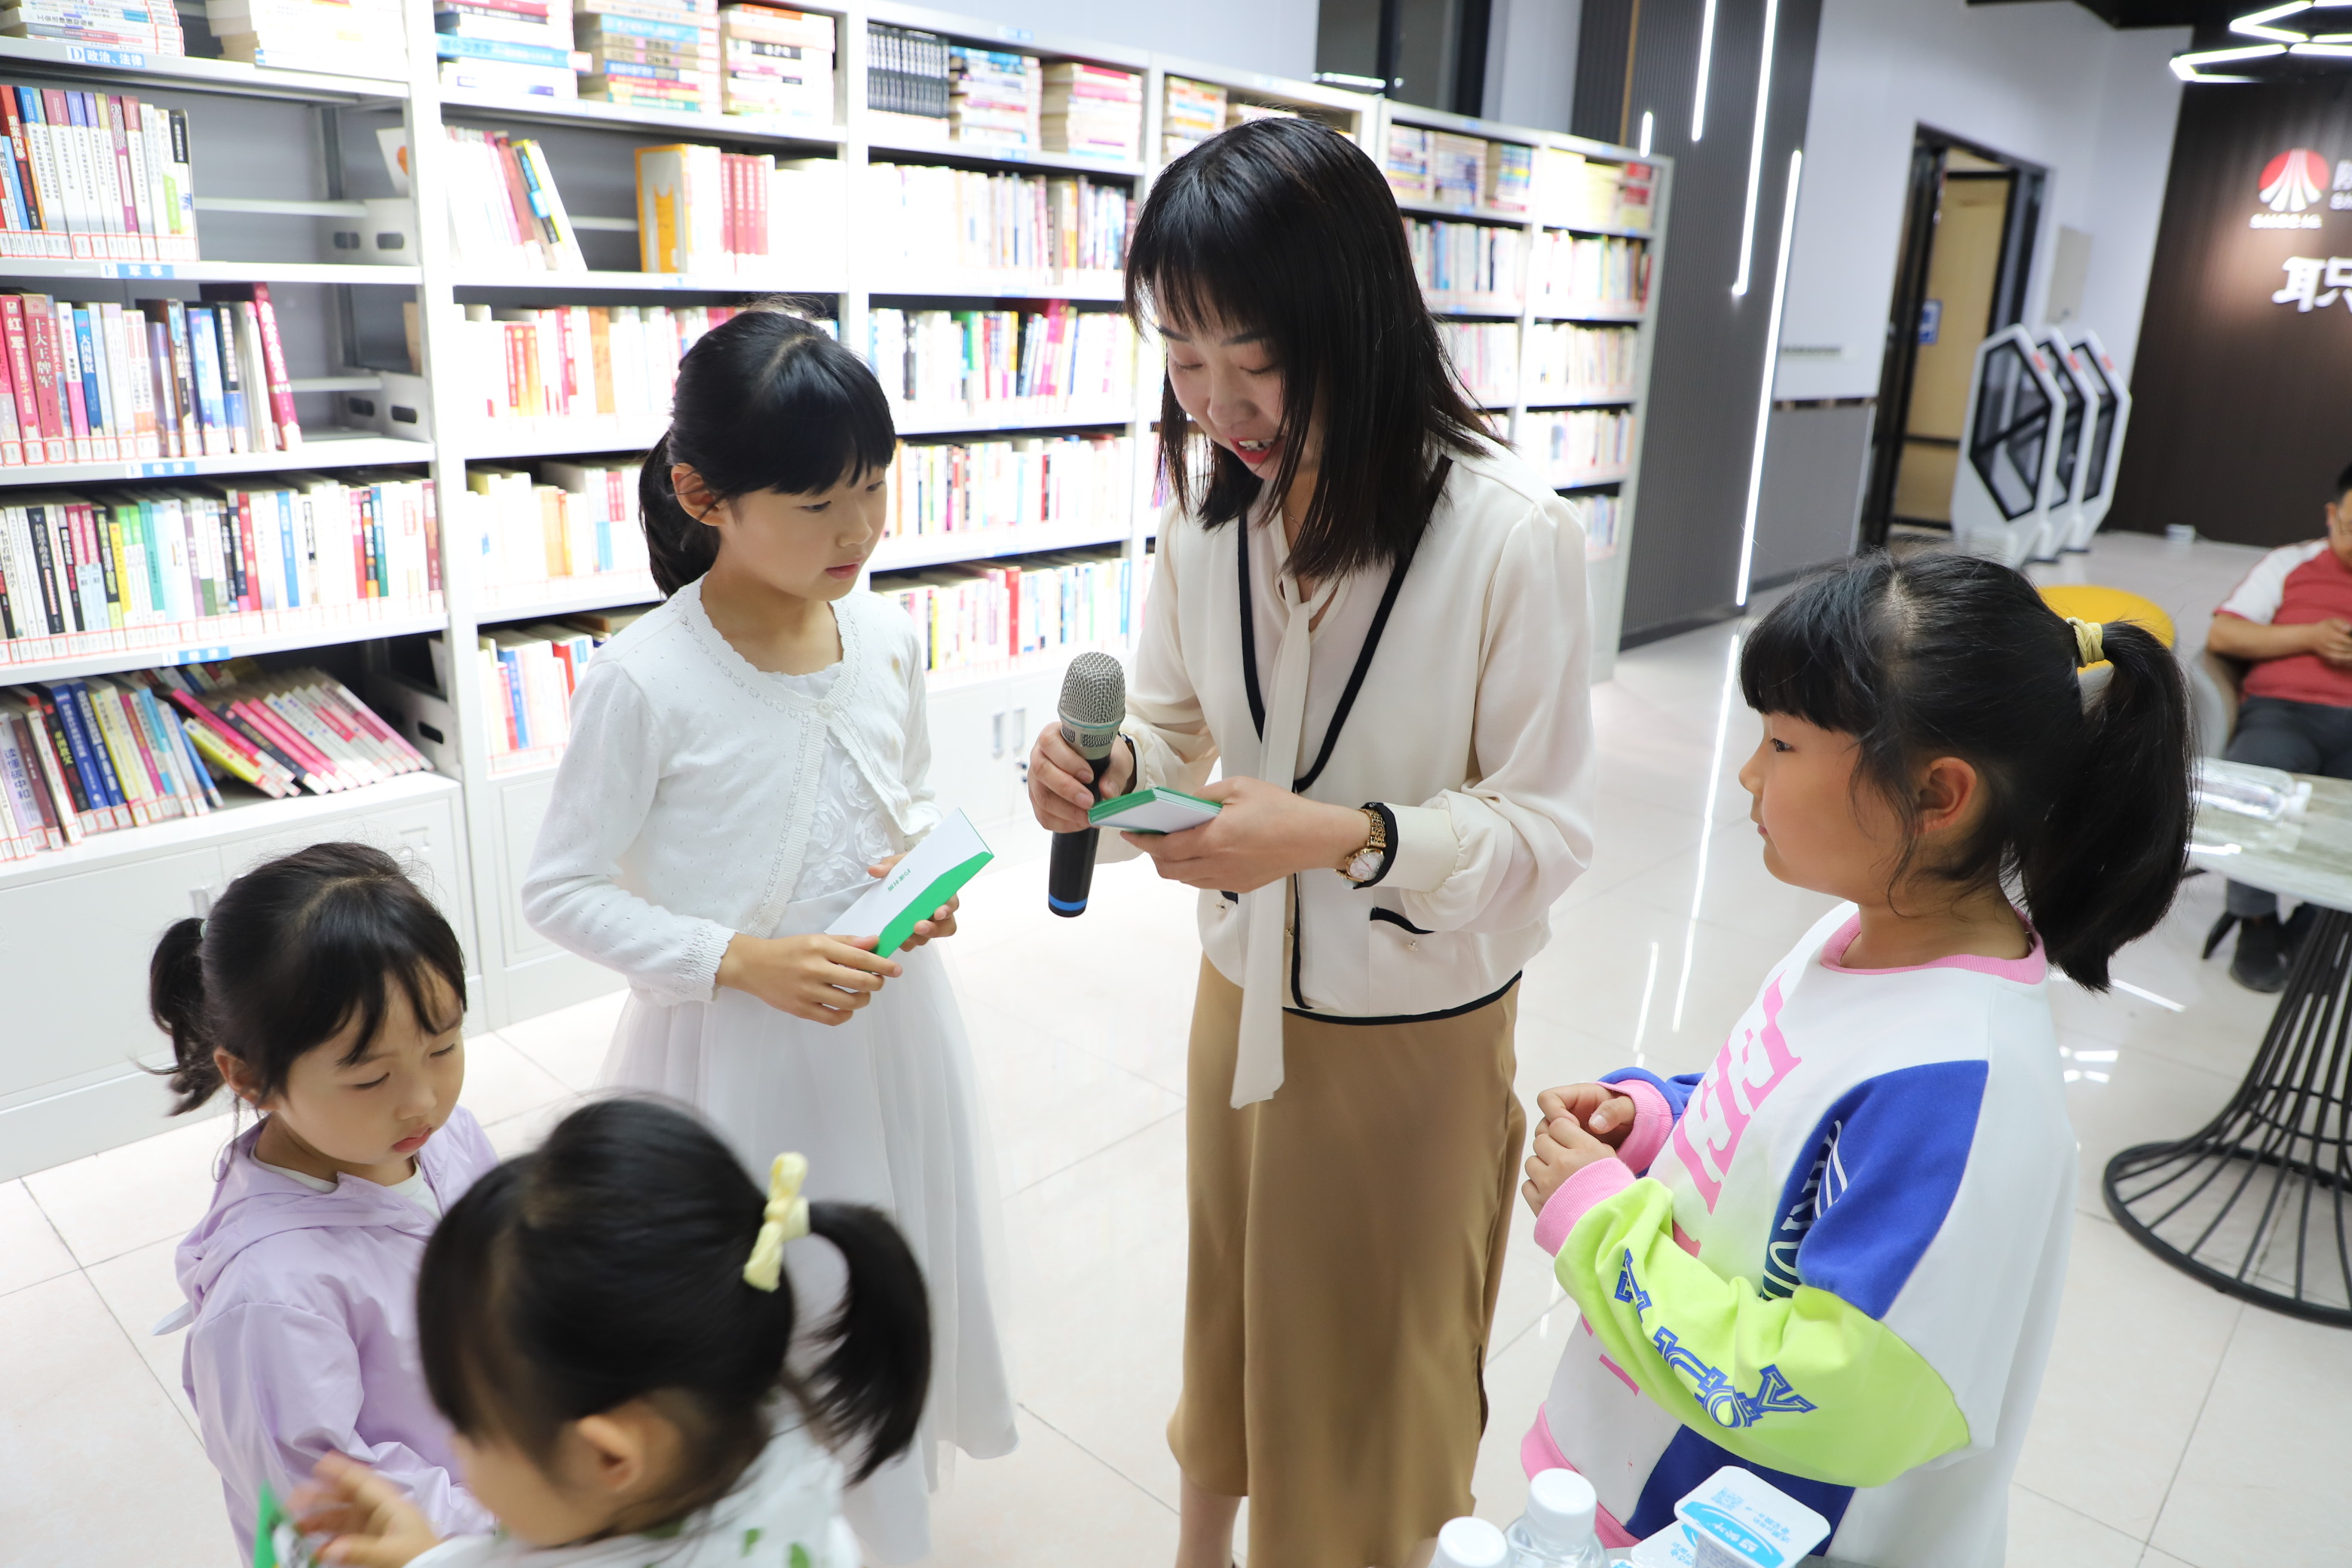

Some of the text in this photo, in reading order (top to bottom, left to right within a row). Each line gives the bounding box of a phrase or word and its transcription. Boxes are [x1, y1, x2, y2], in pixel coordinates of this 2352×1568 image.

[69, 47, 144, 67] D 政治、法律
[8, 115, 27, 159] 重案内幕
[7, 317, 27, 350] 红军
[29, 317, 54, 389] 十大王牌军
[79, 334, 96, 375] 大国海权
[152, 464, 186, 474] 经济
[5, 746, 32, 799] 读懂碳中和
